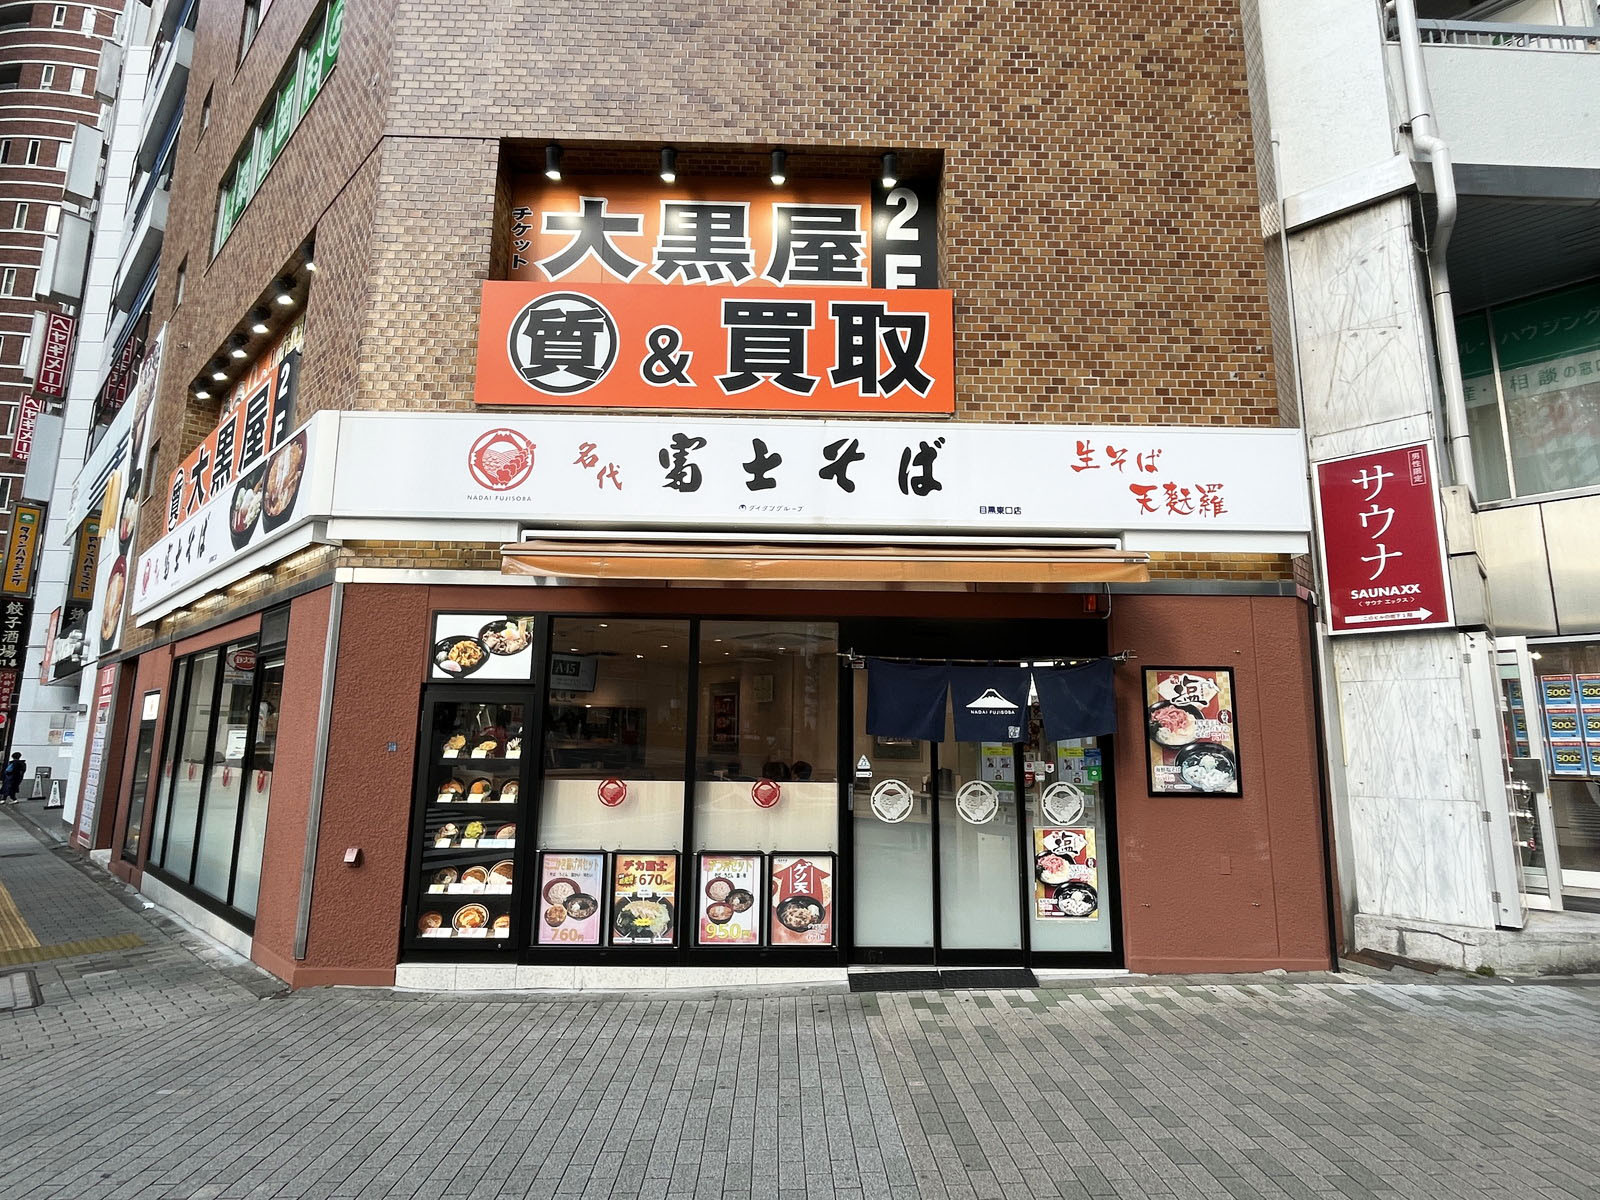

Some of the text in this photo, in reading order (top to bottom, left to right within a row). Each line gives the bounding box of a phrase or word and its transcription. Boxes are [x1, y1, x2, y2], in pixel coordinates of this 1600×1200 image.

[511, 206, 533, 270] チケット
[534, 195, 868, 287] 大黒屋
[884, 187, 922, 289] 2F
[519, 298, 936, 399] 質 & 買取
[42, 386, 57, 394] 4F
[272, 362, 291, 449] 2F
[186, 377, 272, 518] 大黒屋
[573, 441, 623, 491] 名代
[658, 432, 946, 497] 富士そば
[1069, 440, 1163, 473] 生そば
[1411, 452, 1423, 483] 男性限定
[979, 506, 1022, 515] 目黒東口店
[1129, 481, 1228, 518] 天麩羅
[1351, 465, 1404, 581] サウナ
[11, 526, 31, 586] タウンハウジング
[1350, 583, 1421, 600] SAUNAXX
[0, 601, 24, 659] 餃子酒場
[793, 861, 813, 894] ゲソ天
